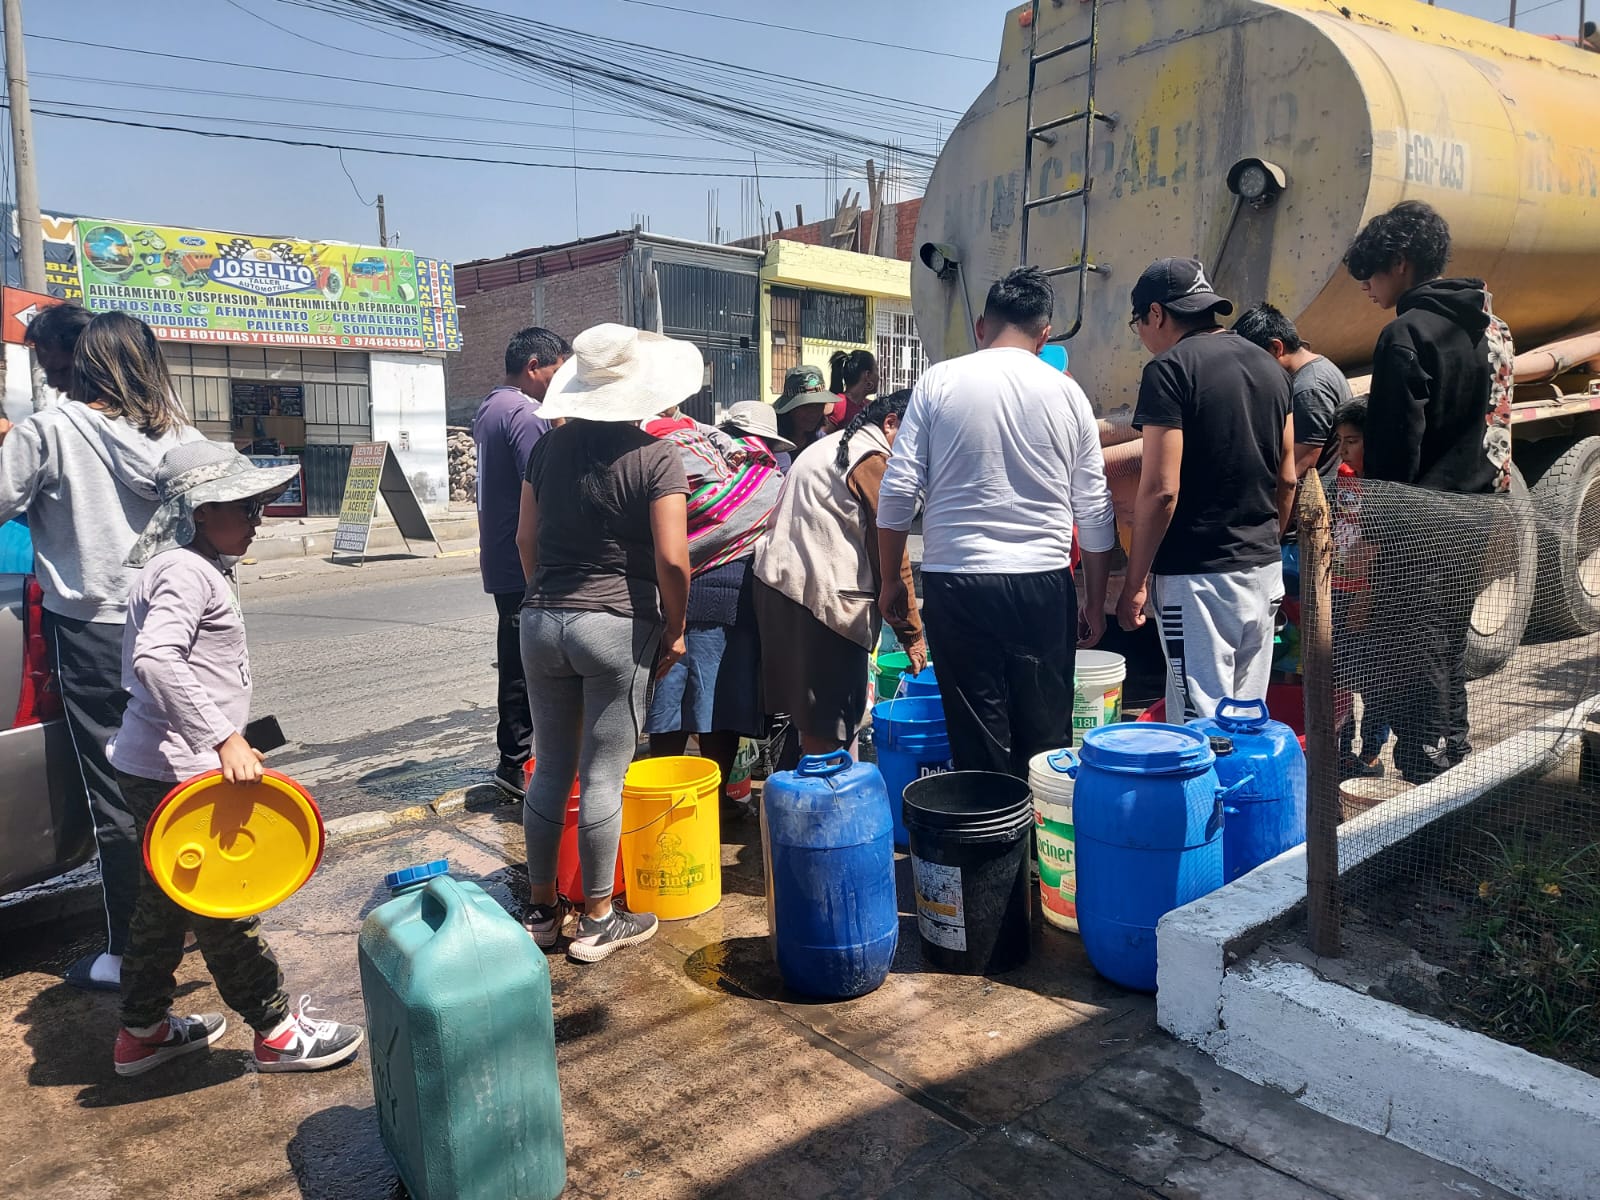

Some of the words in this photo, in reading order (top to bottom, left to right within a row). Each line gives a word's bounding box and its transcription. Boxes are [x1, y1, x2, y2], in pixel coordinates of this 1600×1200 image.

[213, 259, 312, 284] JOSELITO
[239, 280, 290, 293] AUTOMOTRIZ
[249, 277, 280, 286] TALLER
[89, 285, 176, 301] ALINEAMIENTO
[178, 292, 184, 301] Y
[187, 291, 258, 306] SUSPENSION
[266, 297, 349, 311] MANTENIMIENTO
[351, 303, 357, 311] Y
[359, 303, 417, 314] REPARACION
[417, 261, 435, 347] AFINAMIENTO
[430, 262, 445, 349] SUSPENSION
[440, 263, 458, 349] ALINEAMIENTO
[90, 299, 150, 312] FRENOS
[152, 302, 183, 314] ABS
[216, 306, 307, 320] AFINAMIENTO
[332, 312, 419, 326] CREMALLERAS
[247, 320, 310, 333] PALIERES
[342, 325, 420, 337] SOLDADURA
[170, 328, 192, 339] DE
[194, 330, 250, 342] ROTULAS
[251, 332, 259, 343] Y
[261, 333, 337, 346] TERMINALES
[354, 337, 421, 349] 974843944
[349, 480, 375, 489] FRENOS
[344, 490, 366, 501] CAMBIO
[367, 490, 376, 501] DE
[348, 502, 367, 512] ACEITE
[639, 873, 703, 887] Cocinero
